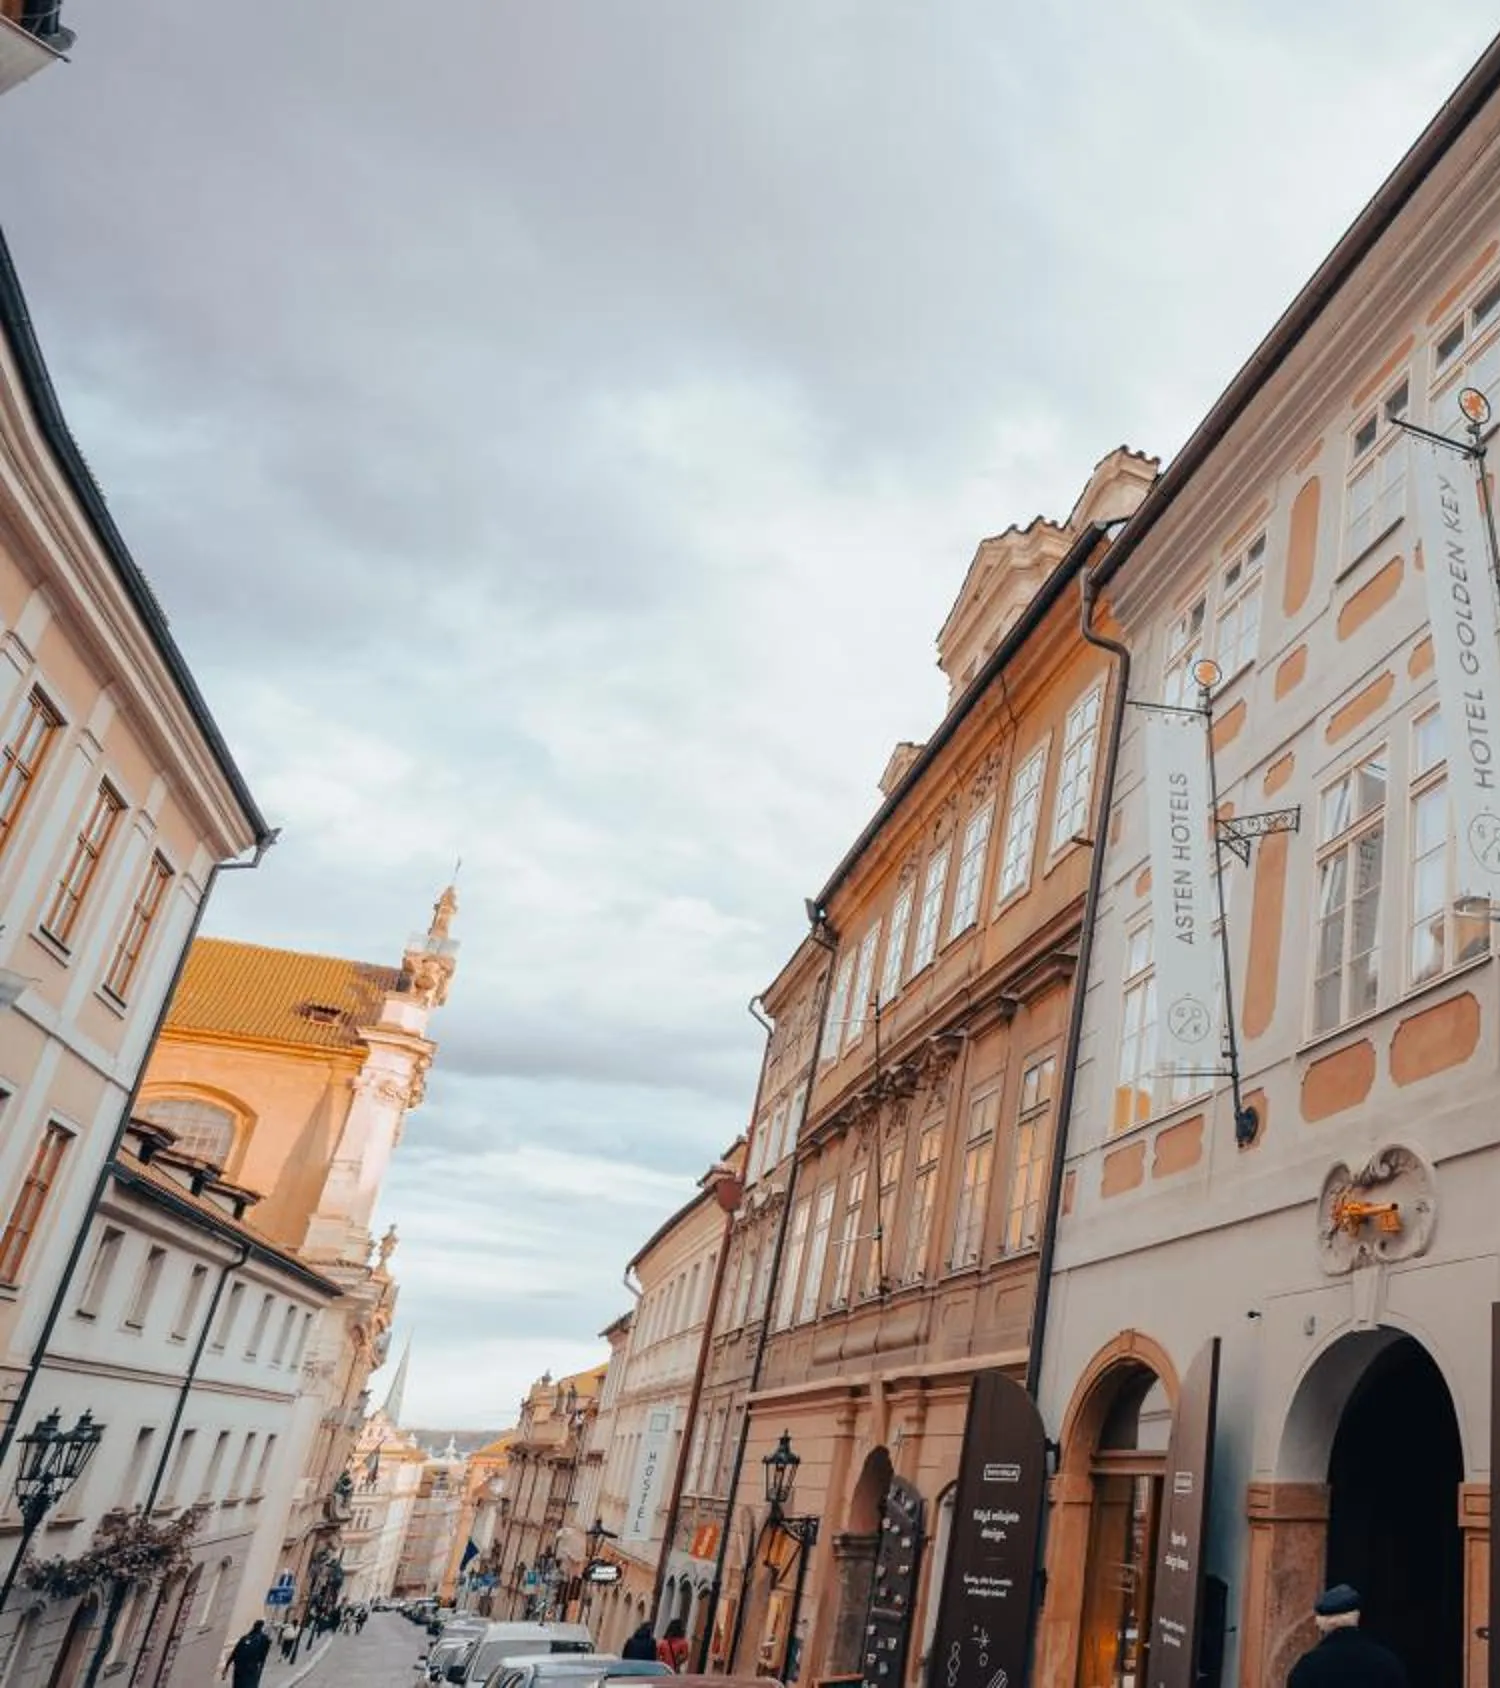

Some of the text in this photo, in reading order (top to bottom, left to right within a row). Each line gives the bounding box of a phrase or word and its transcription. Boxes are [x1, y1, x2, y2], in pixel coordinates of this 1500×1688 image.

[1437, 475, 1496, 790] HOTEL GOLDEN KEY
[1169, 772, 1194, 945] ASTEN HOTELS
